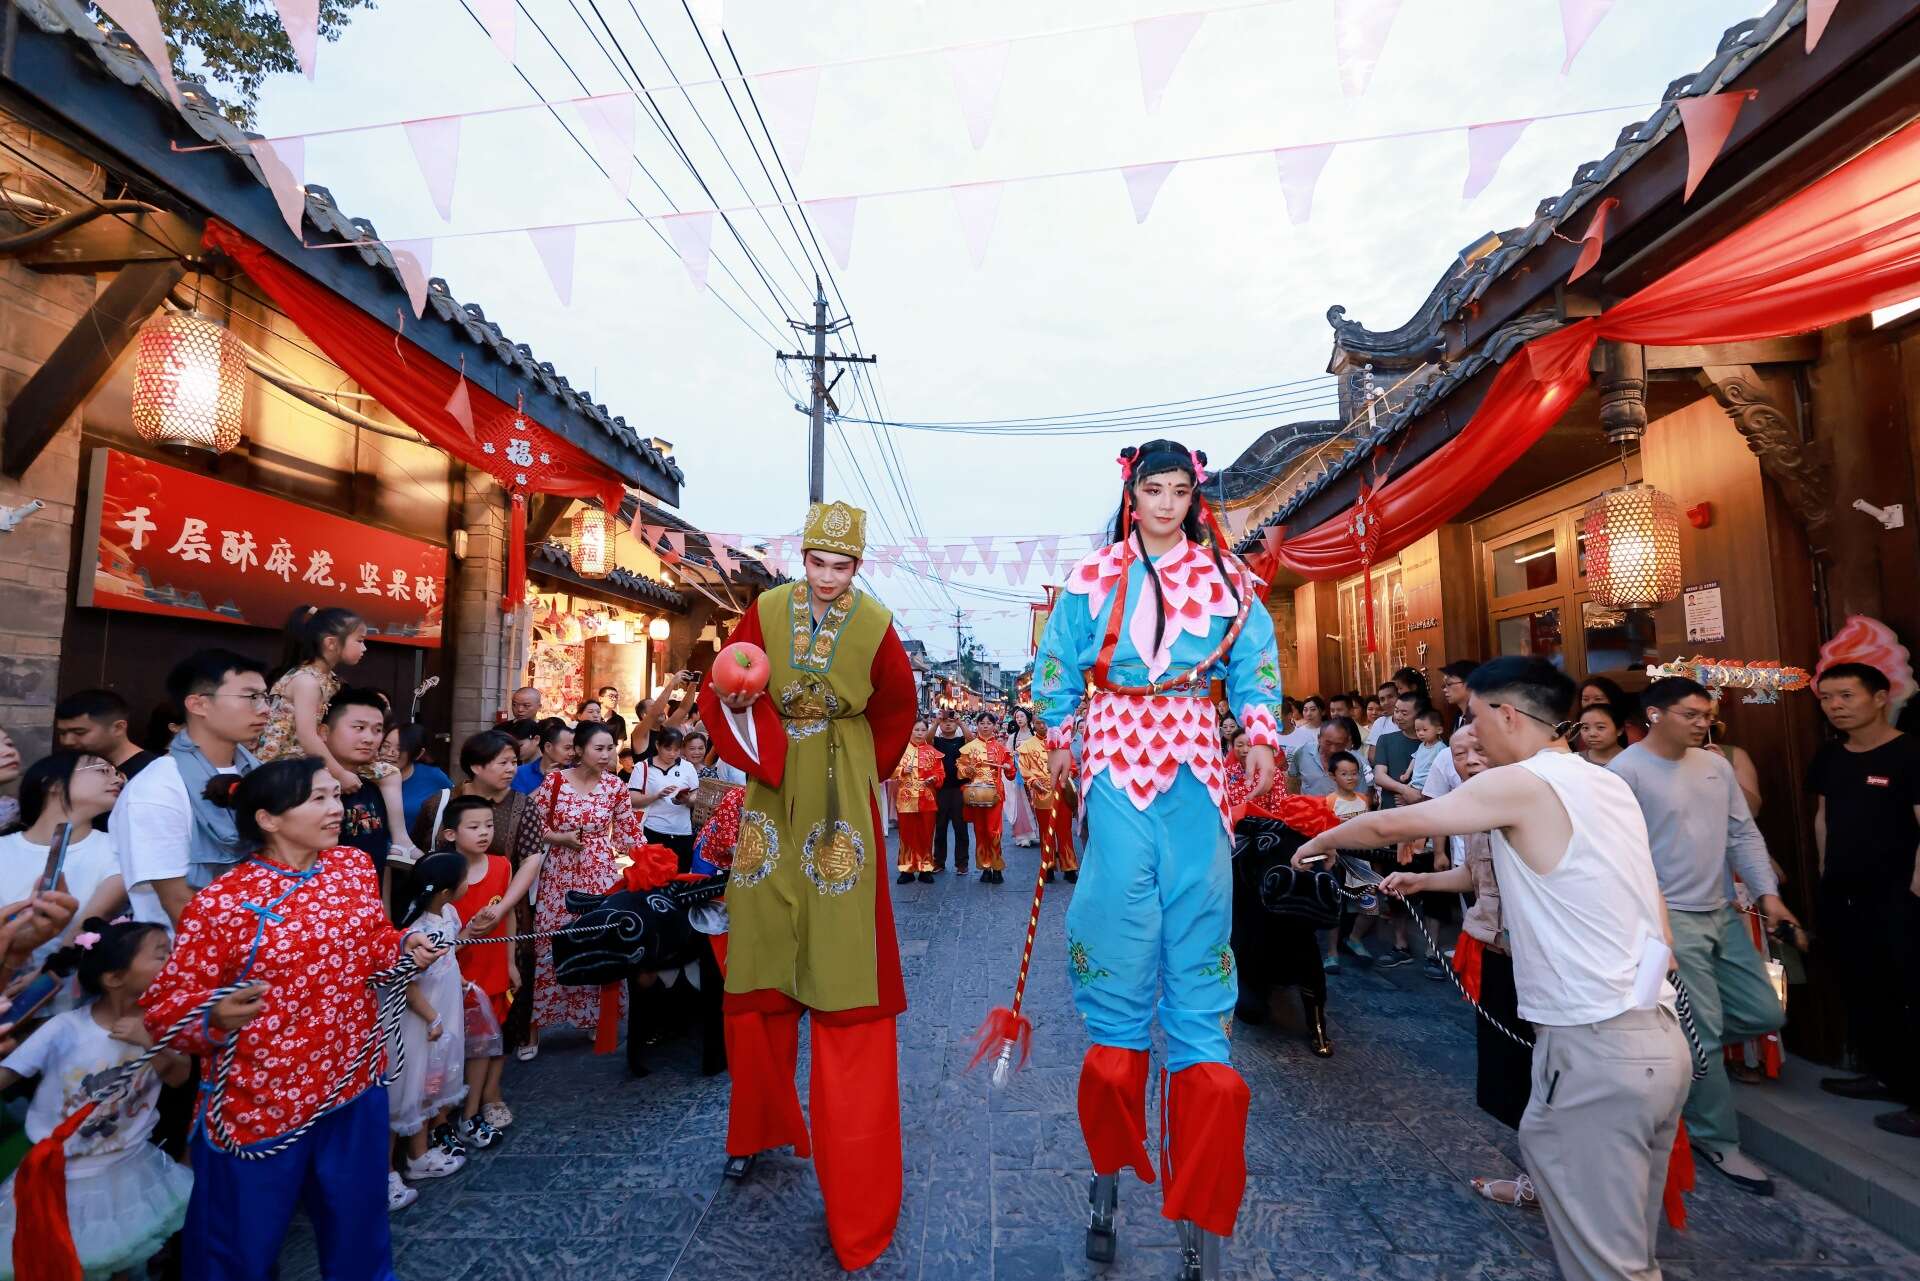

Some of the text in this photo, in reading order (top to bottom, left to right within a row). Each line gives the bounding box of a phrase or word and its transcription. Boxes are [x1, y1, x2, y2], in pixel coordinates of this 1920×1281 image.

[115, 506, 437, 608] 千层酥麻花，坚果酥
